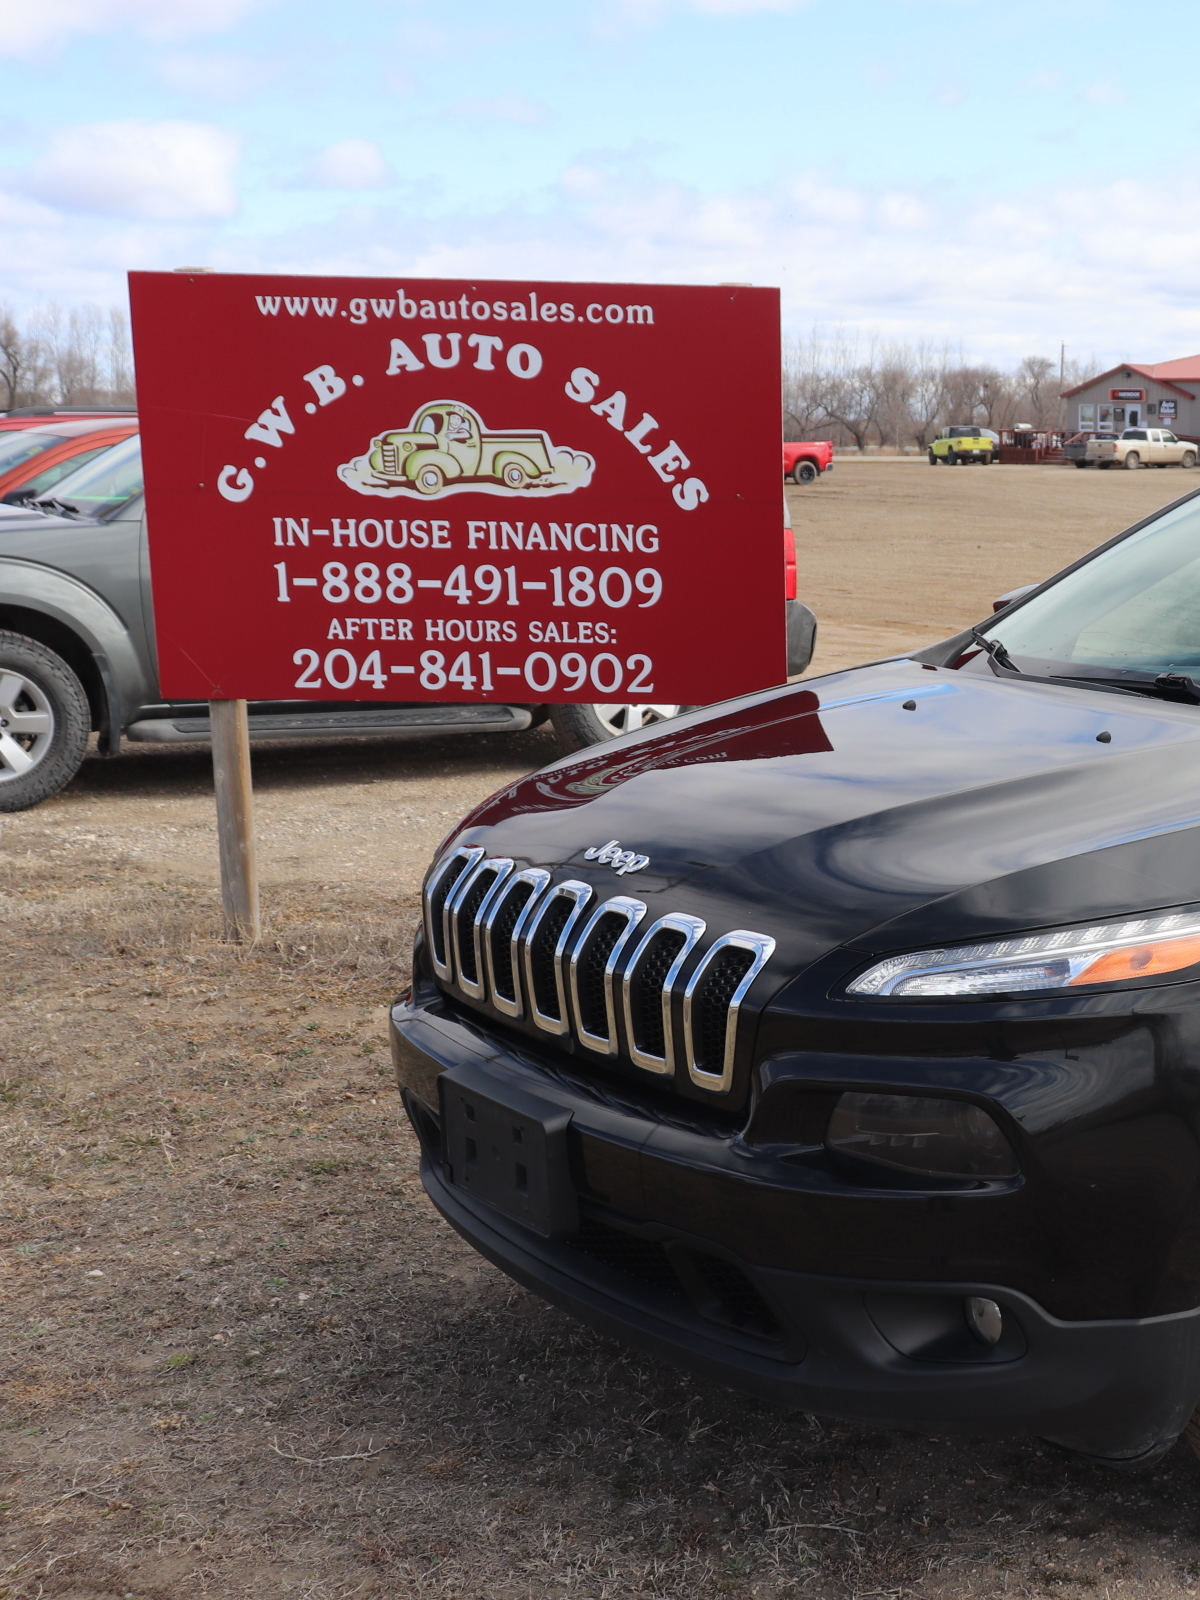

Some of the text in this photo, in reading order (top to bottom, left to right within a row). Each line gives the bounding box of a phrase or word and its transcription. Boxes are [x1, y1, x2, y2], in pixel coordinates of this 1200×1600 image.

[255, 289, 655, 324] www.gwbautosales.com
[385, 332, 543, 379] AUTO
[564, 367, 709, 511] SALES
[272, 517, 660, 553] IN-HOUSE FINANCING
[273, 561, 663, 608] 1-888-491-1809
[327, 618, 617, 644] AFTER HOURS SALES:
[292, 648, 655, 693] 204-841-0902
[584, 840, 650, 877] Jeep
